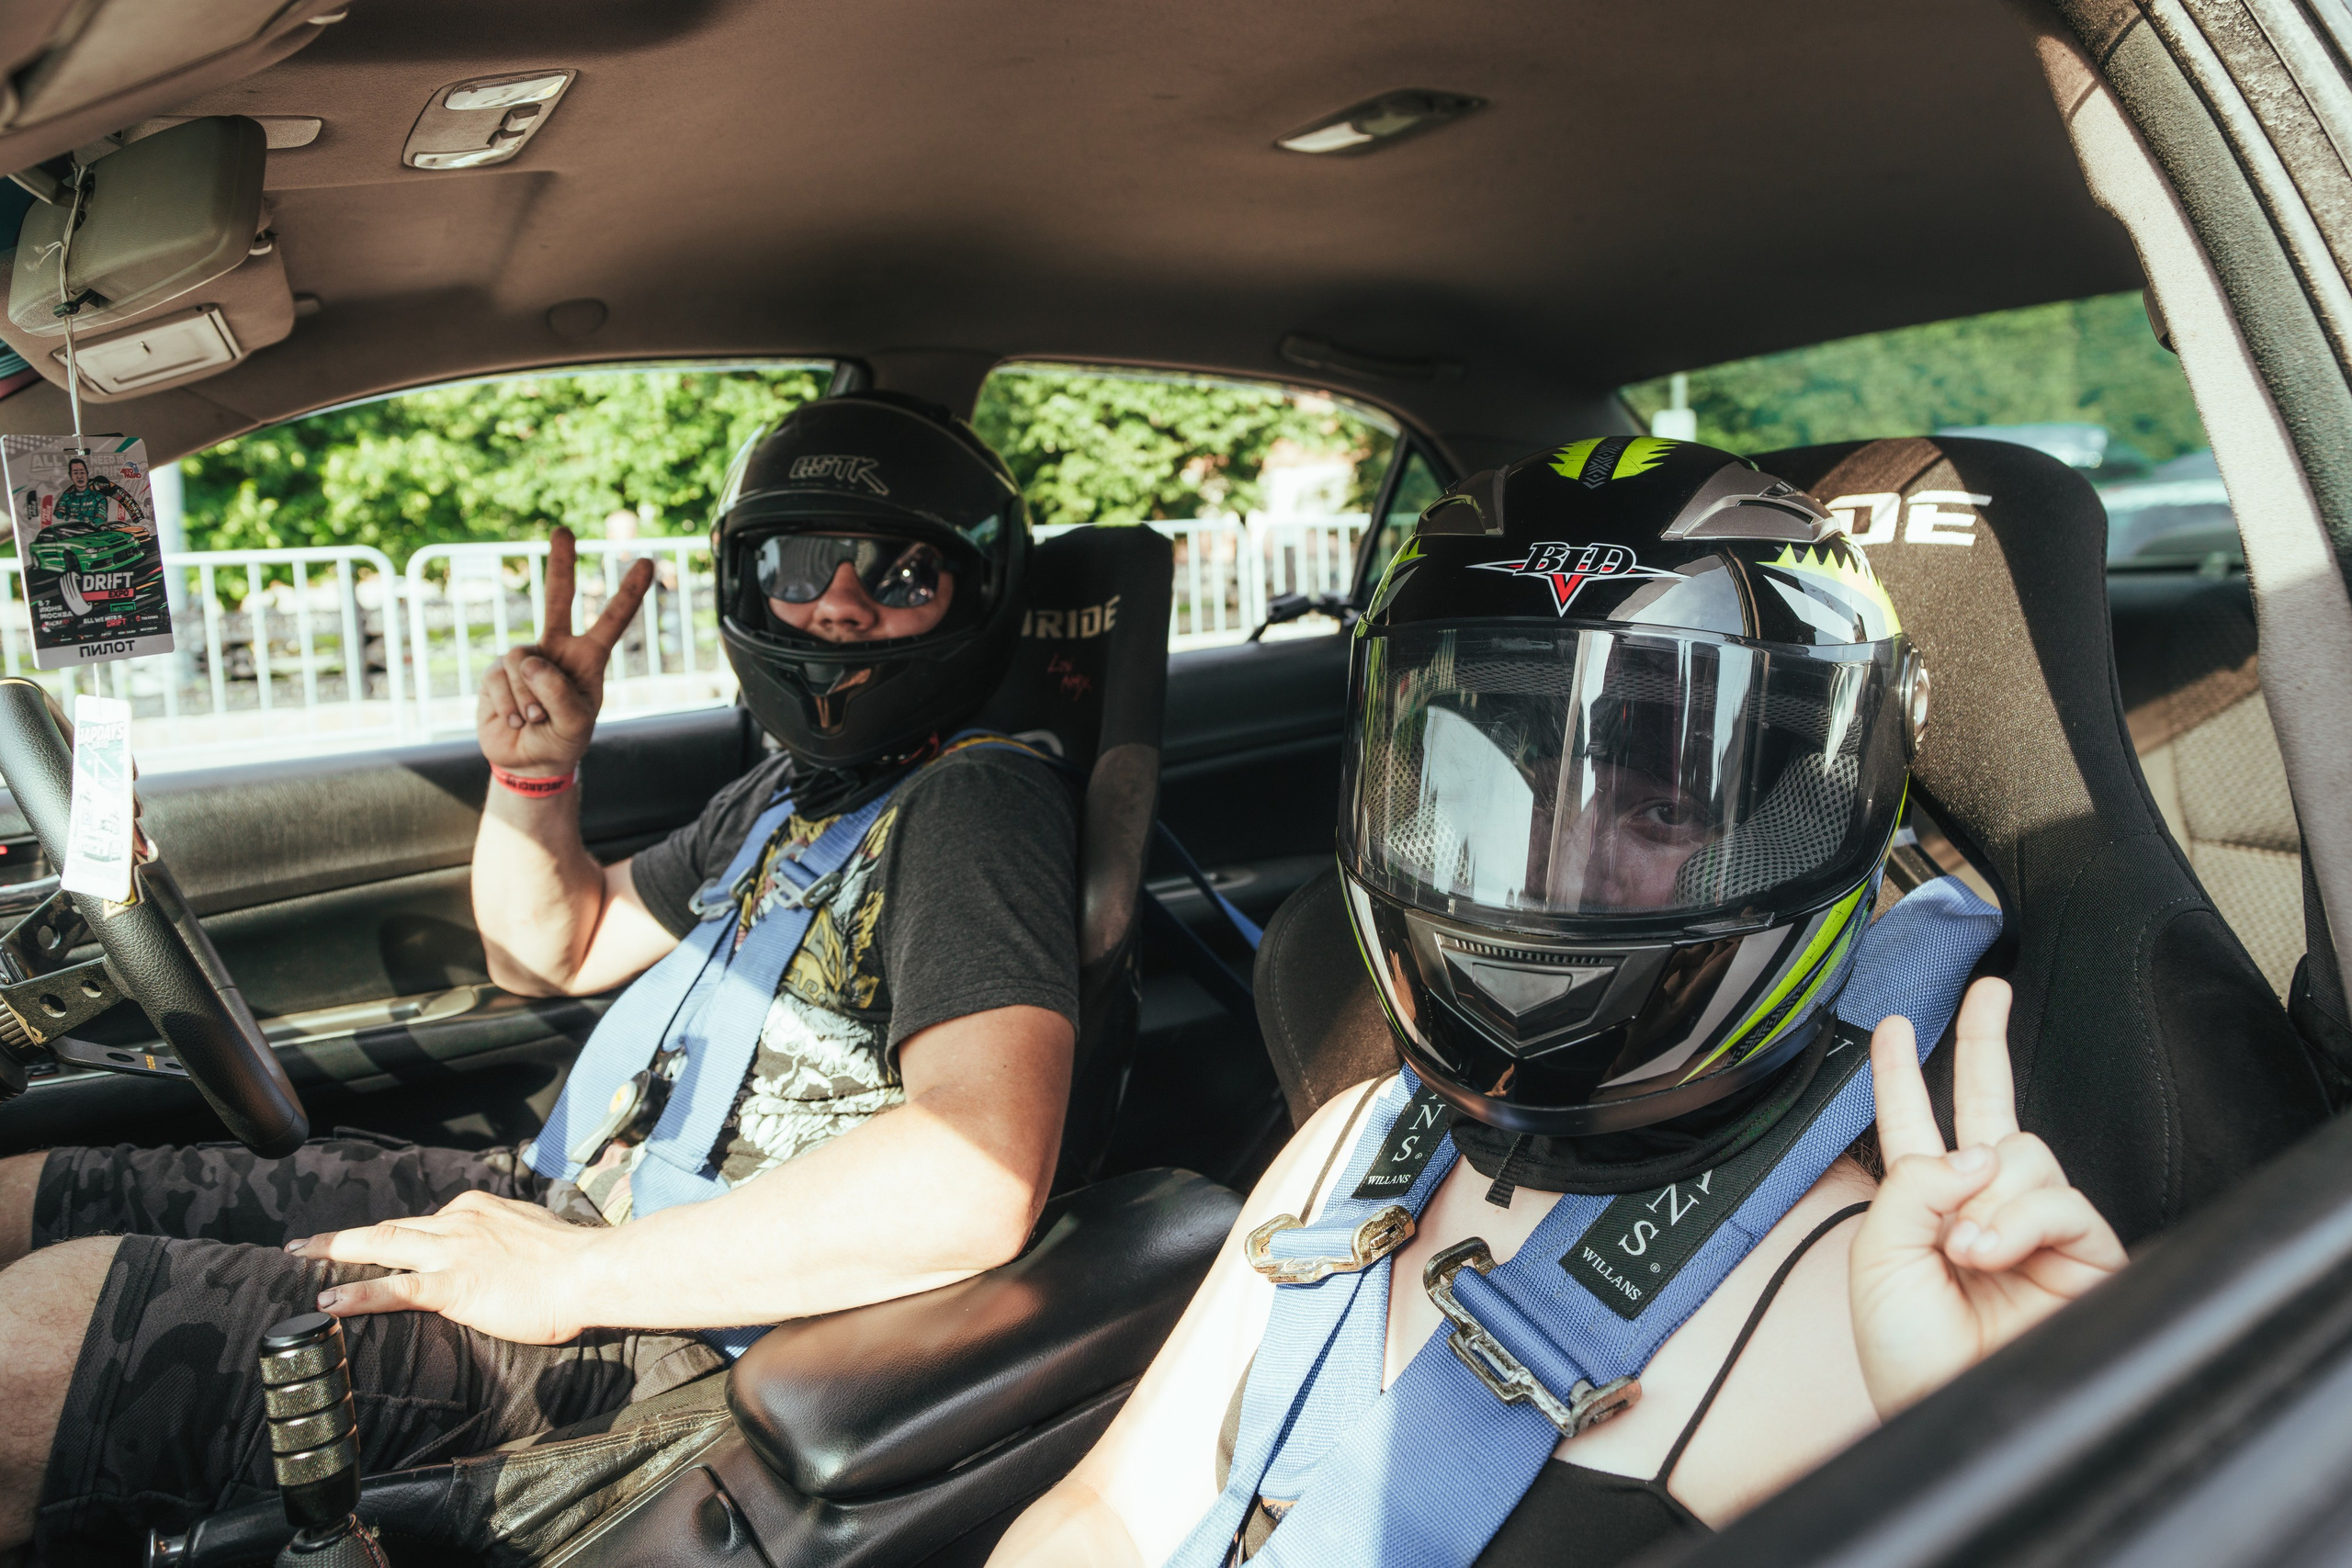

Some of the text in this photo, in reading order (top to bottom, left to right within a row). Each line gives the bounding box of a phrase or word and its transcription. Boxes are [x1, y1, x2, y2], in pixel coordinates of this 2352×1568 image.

[82, 571, 134, 592] DRIFT
[108, 590, 130, 598] EXPO
[40, 611, 74, 620] МОСКВА
[1020, 594, 1122, 639] RIDE
[79, 640, 135, 658] ПИЛОТ
[77, 721, 125, 746] JAPDAYS
[1367, 1174, 1412, 1185] WILLANS
[1582, 1247, 1643, 1301] WILLANS
